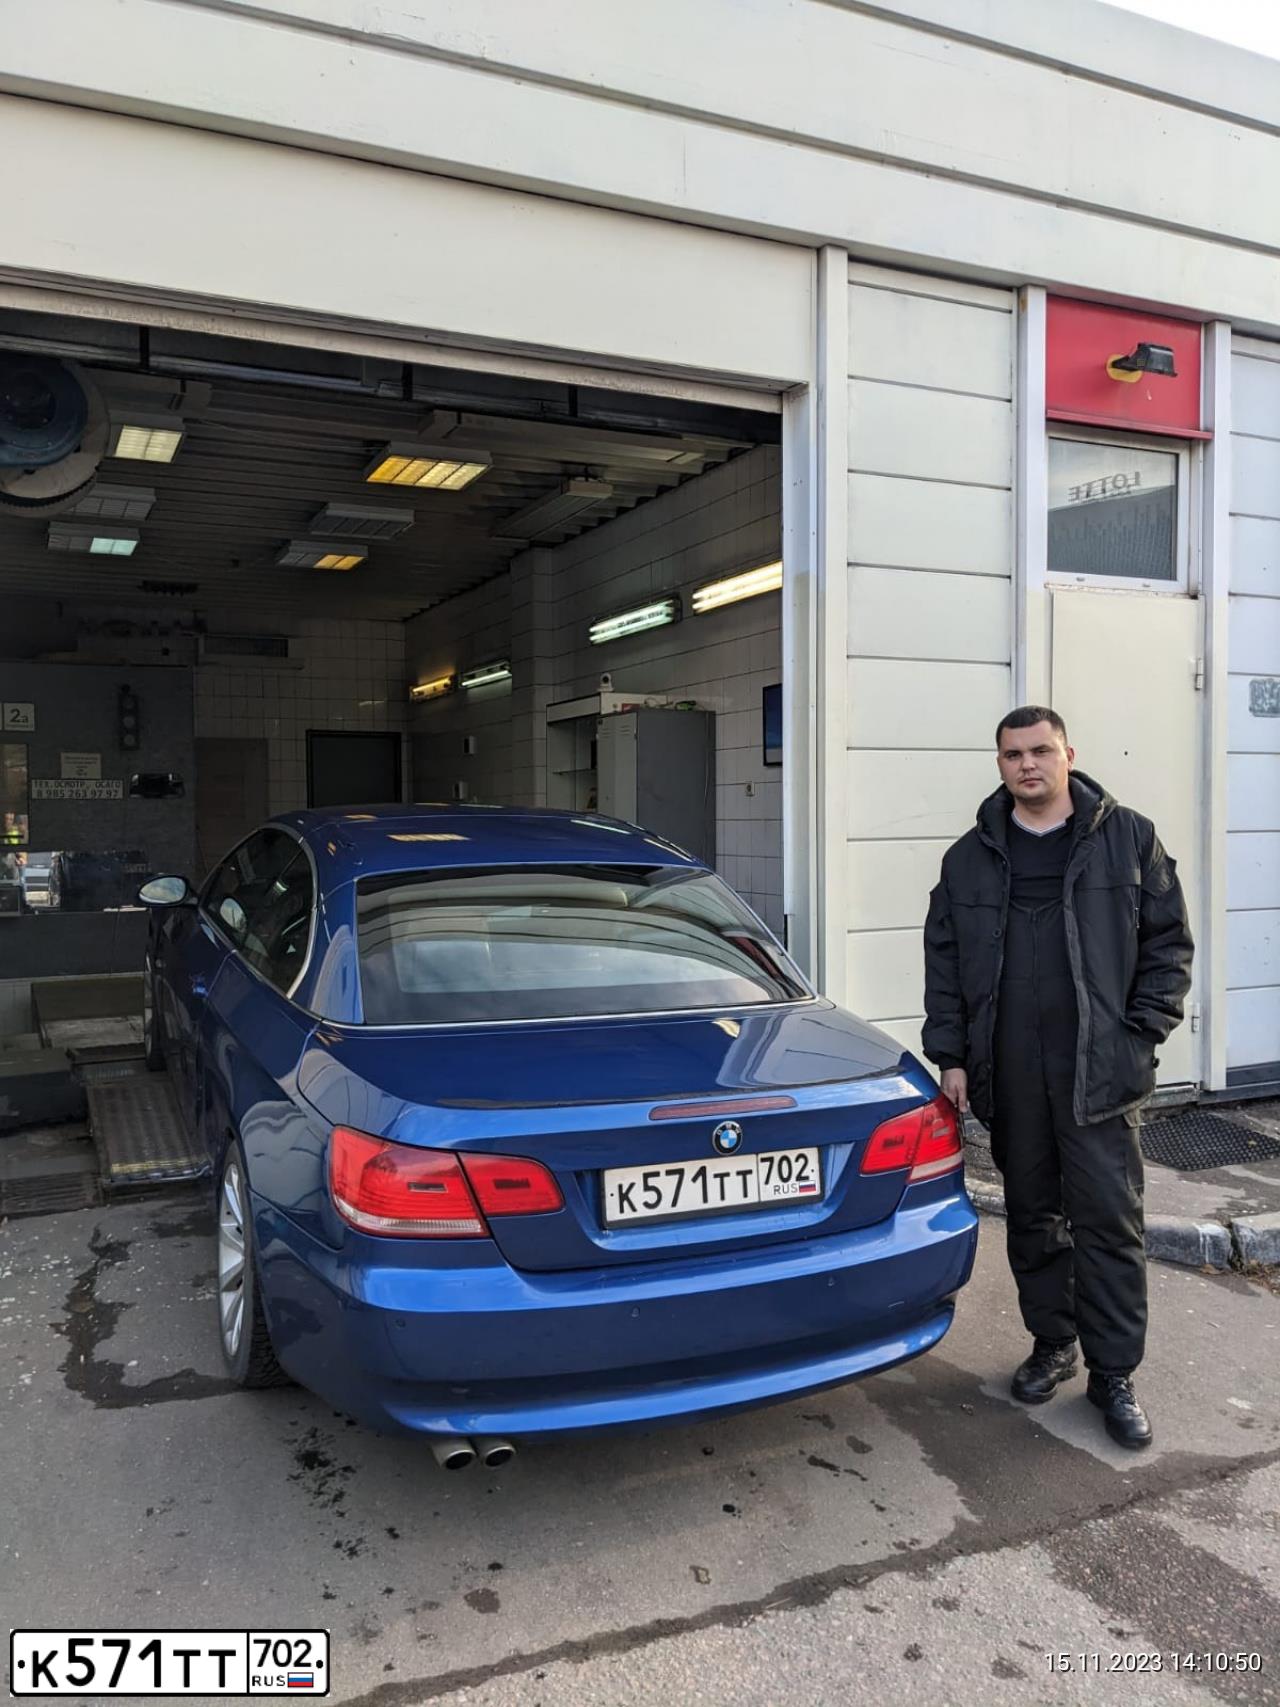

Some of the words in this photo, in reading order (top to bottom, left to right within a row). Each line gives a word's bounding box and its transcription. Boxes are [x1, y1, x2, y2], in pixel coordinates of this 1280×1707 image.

[618, 1166, 753, 1214] К571ТТ
[760, 1153, 809, 1185] 702
[773, 1182, 798, 1196] RUS
